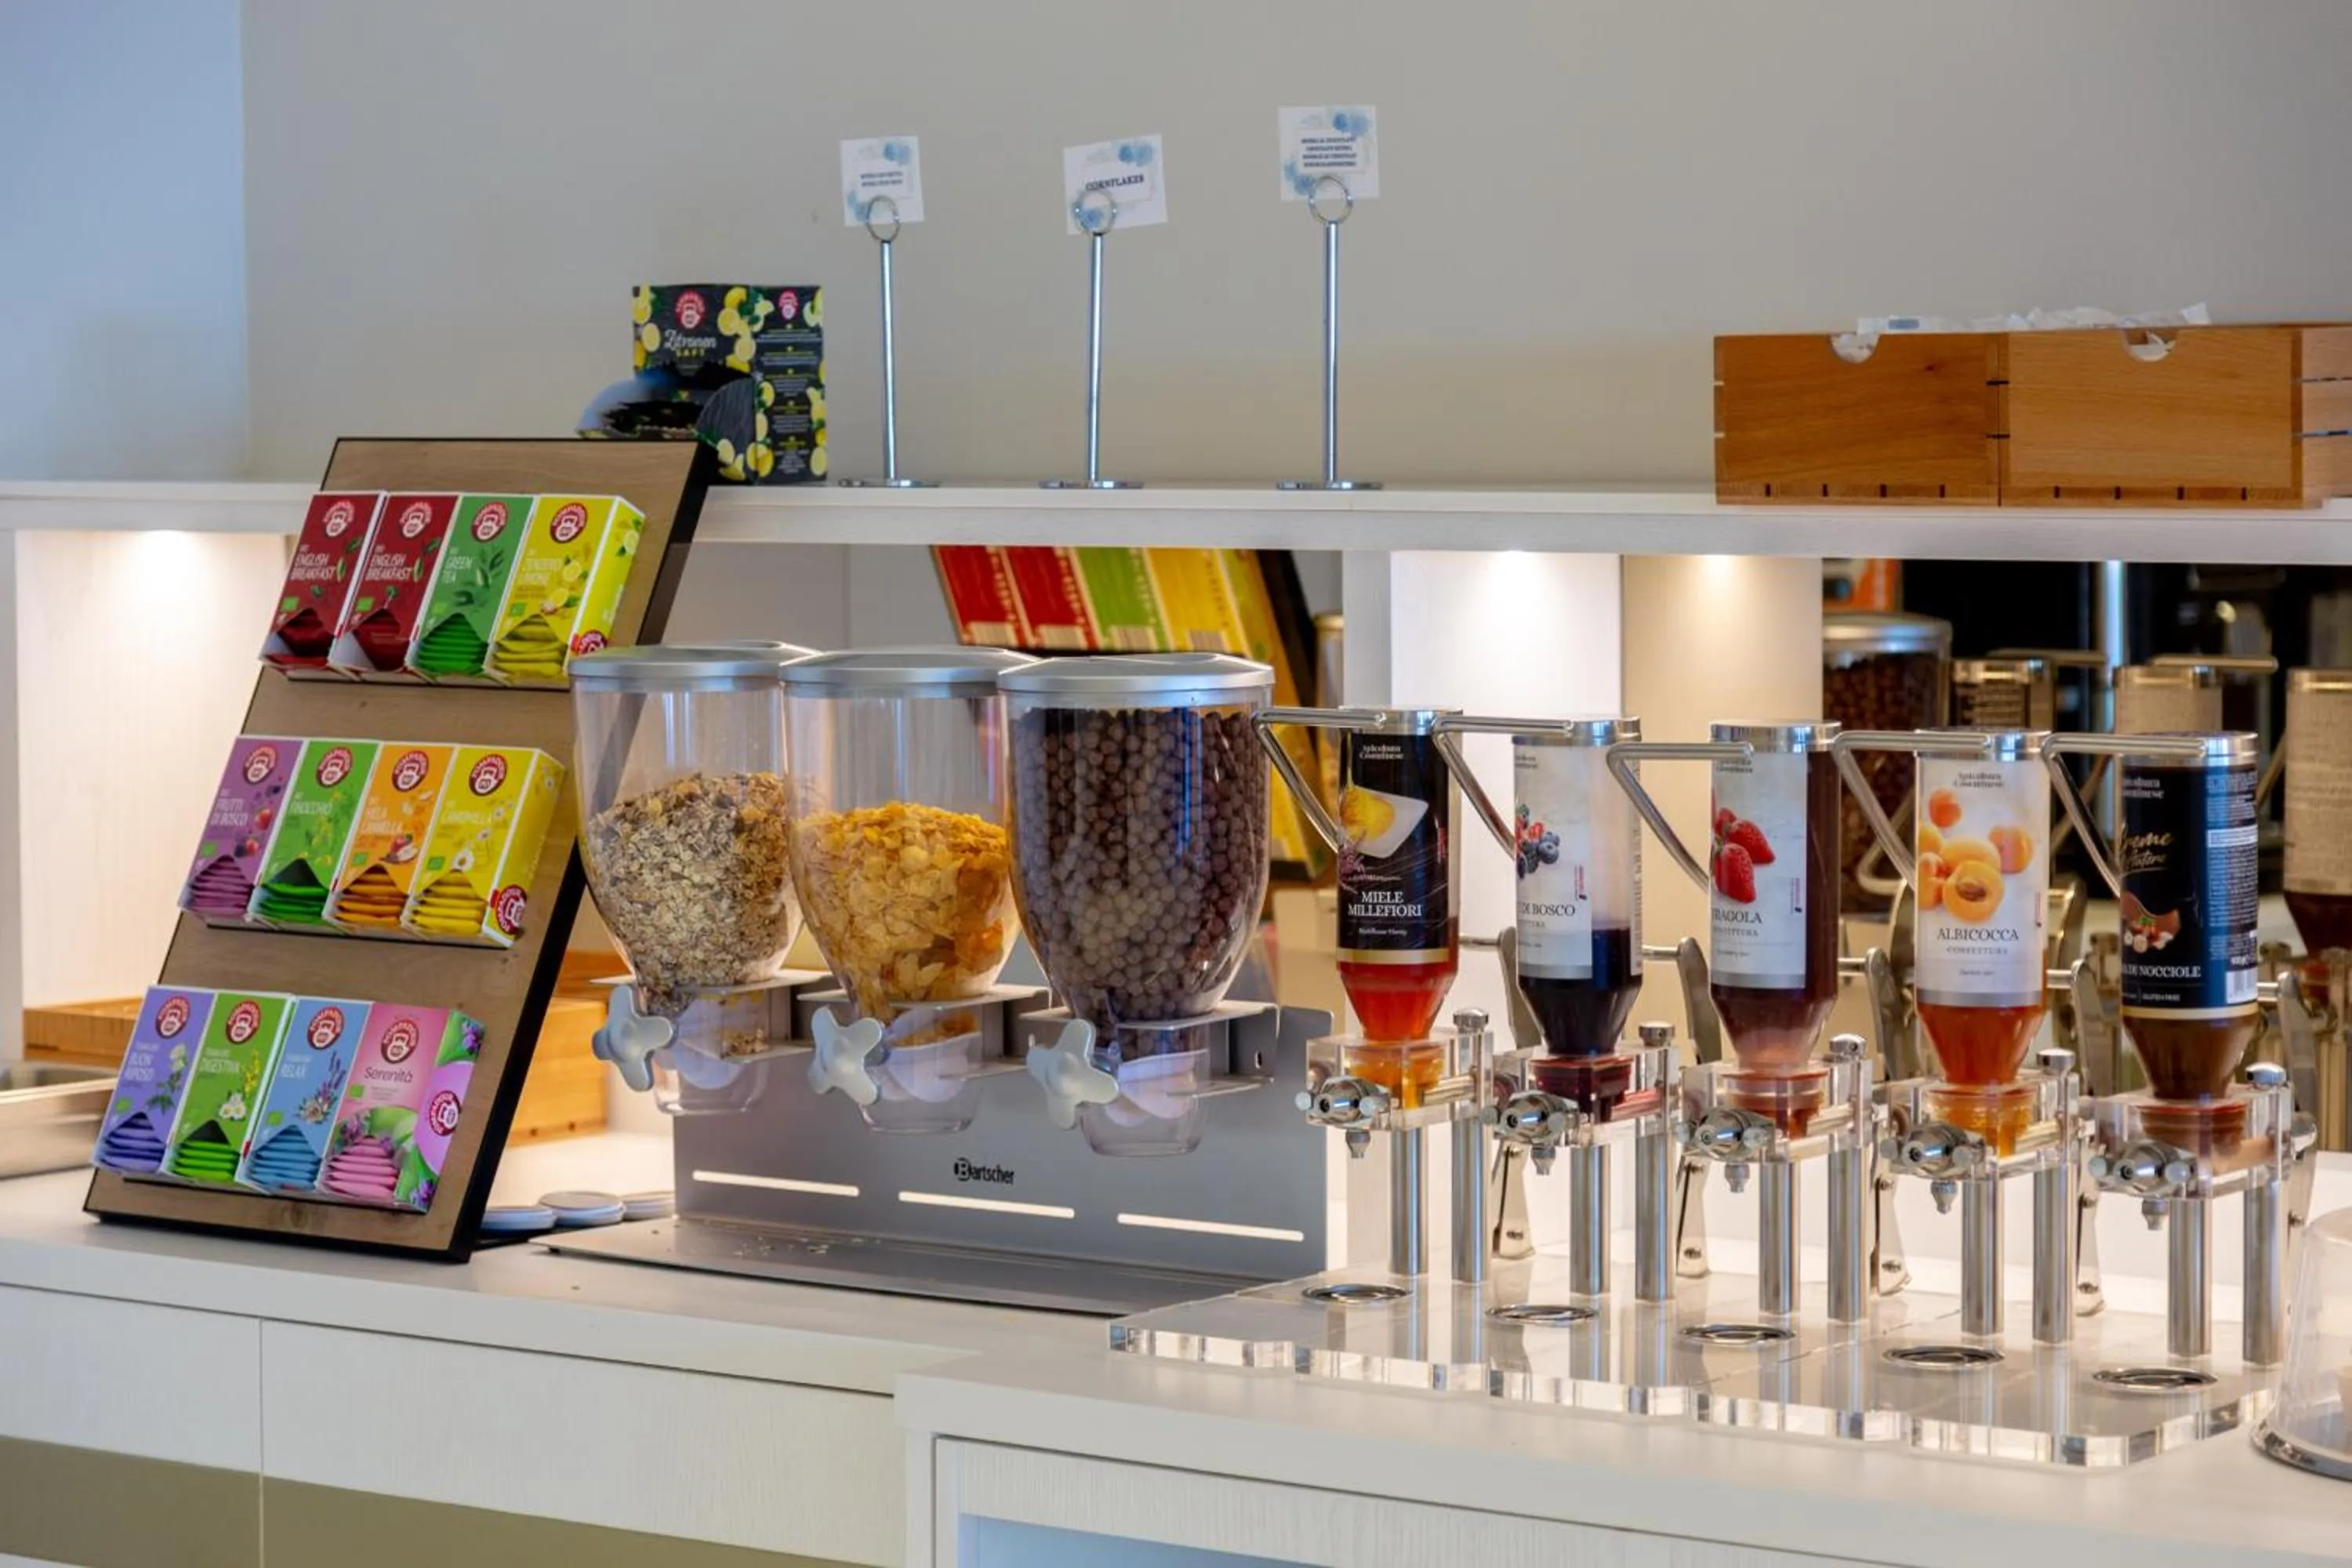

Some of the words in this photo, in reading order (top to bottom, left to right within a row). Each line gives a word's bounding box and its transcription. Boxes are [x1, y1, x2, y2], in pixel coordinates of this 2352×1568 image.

[1086, 174, 1145, 191] CORNFLAKES
[295, 554, 329, 567] ENGLISH
[370, 554, 406, 567] ENGLISH
[289, 567, 336, 581] BREAKFAST
[365, 567, 412, 581] BREAKFAST
[1362, 891, 1403, 903] MIELE
[1348, 904, 1422, 916] MILLEFIORI
[1532, 903, 1576, 916] BOSCO
[1936, 927, 2020, 942] ALBICOCCA
[2139, 965, 2201, 979] NOCCIOLE
[364, 1066, 413, 1083] Serenità
